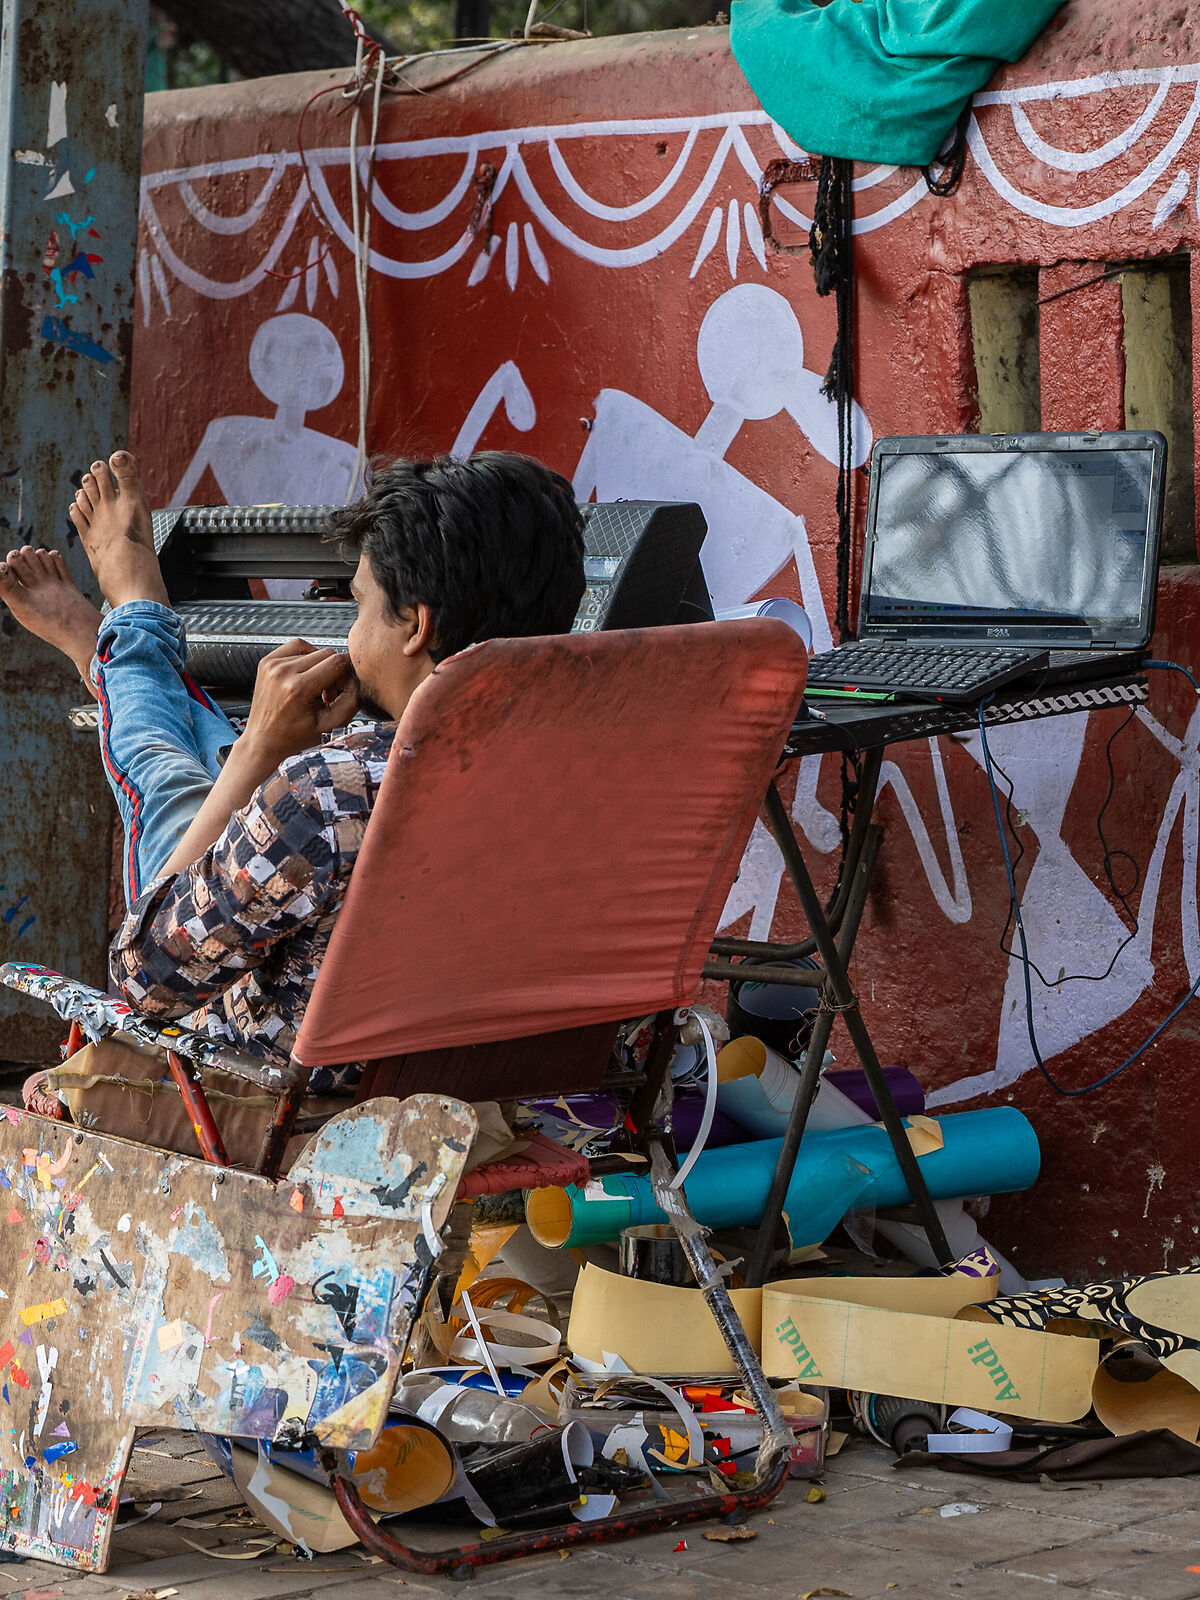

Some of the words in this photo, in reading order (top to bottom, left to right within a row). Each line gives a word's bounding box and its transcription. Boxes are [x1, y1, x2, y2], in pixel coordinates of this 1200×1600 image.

[986, 627, 1011, 638] DELL
[775, 1316, 823, 1380] Audi
[967, 1337, 1021, 1401] Audi
